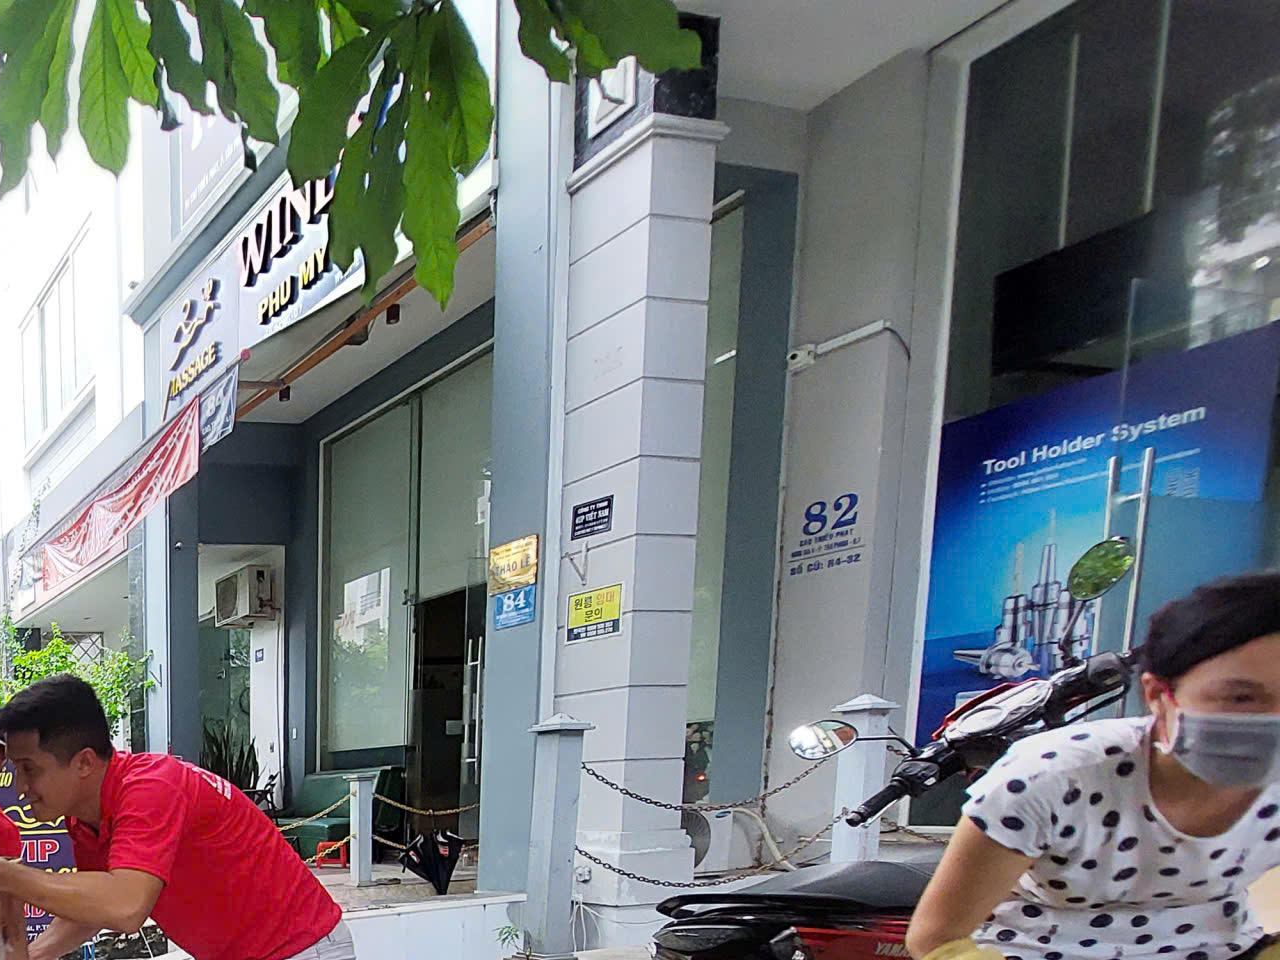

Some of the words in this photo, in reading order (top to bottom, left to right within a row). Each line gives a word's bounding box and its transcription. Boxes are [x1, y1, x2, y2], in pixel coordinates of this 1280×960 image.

[982, 451, 1027, 476] Tool
[1031, 431, 1107, 464] Holder
[1111, 406, 1208, 442] System
[802, 492, 859, 536] 82
[503, 588, 527, 612] 84
